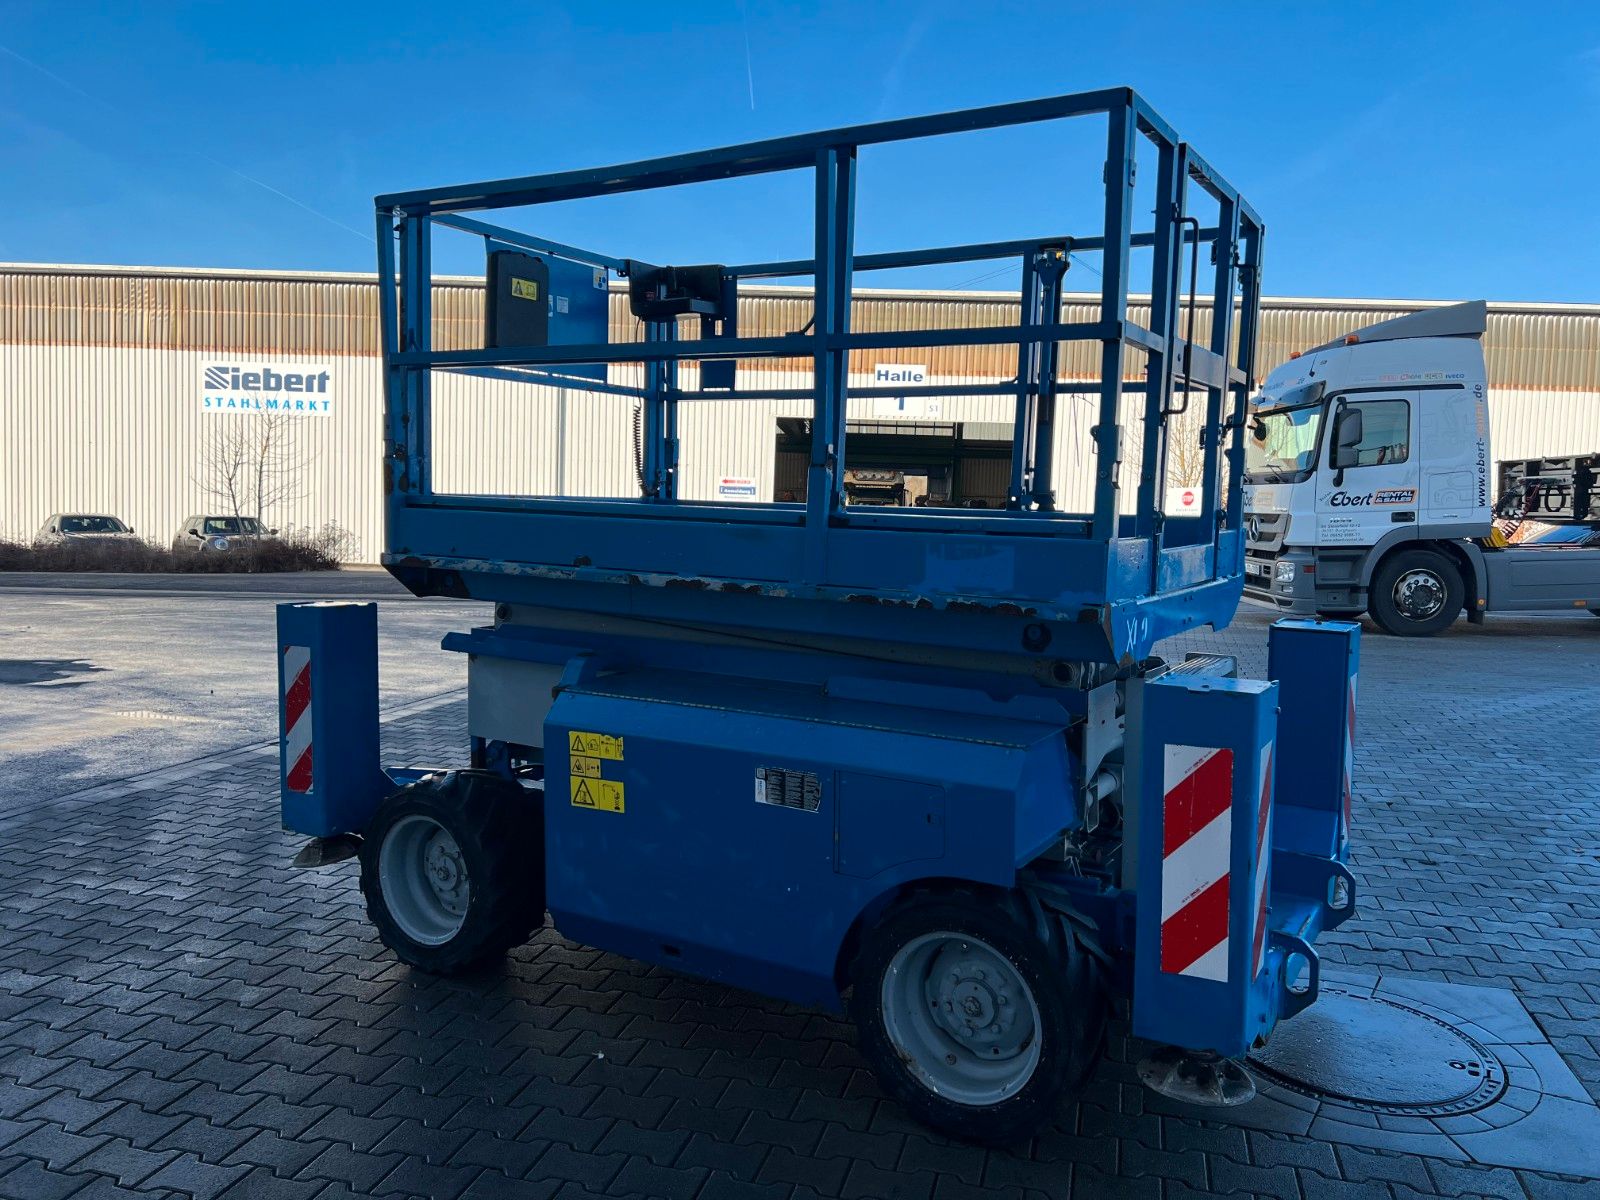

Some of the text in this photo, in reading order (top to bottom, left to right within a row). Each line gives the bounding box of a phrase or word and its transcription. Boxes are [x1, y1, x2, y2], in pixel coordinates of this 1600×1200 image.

[204, 366, 330, 393] Siebert
[877, 369, 924, 382] Halle
[204, 396, 330, 411] STAHLMARKT
[1330, 491, 1373, 507] Ebert
